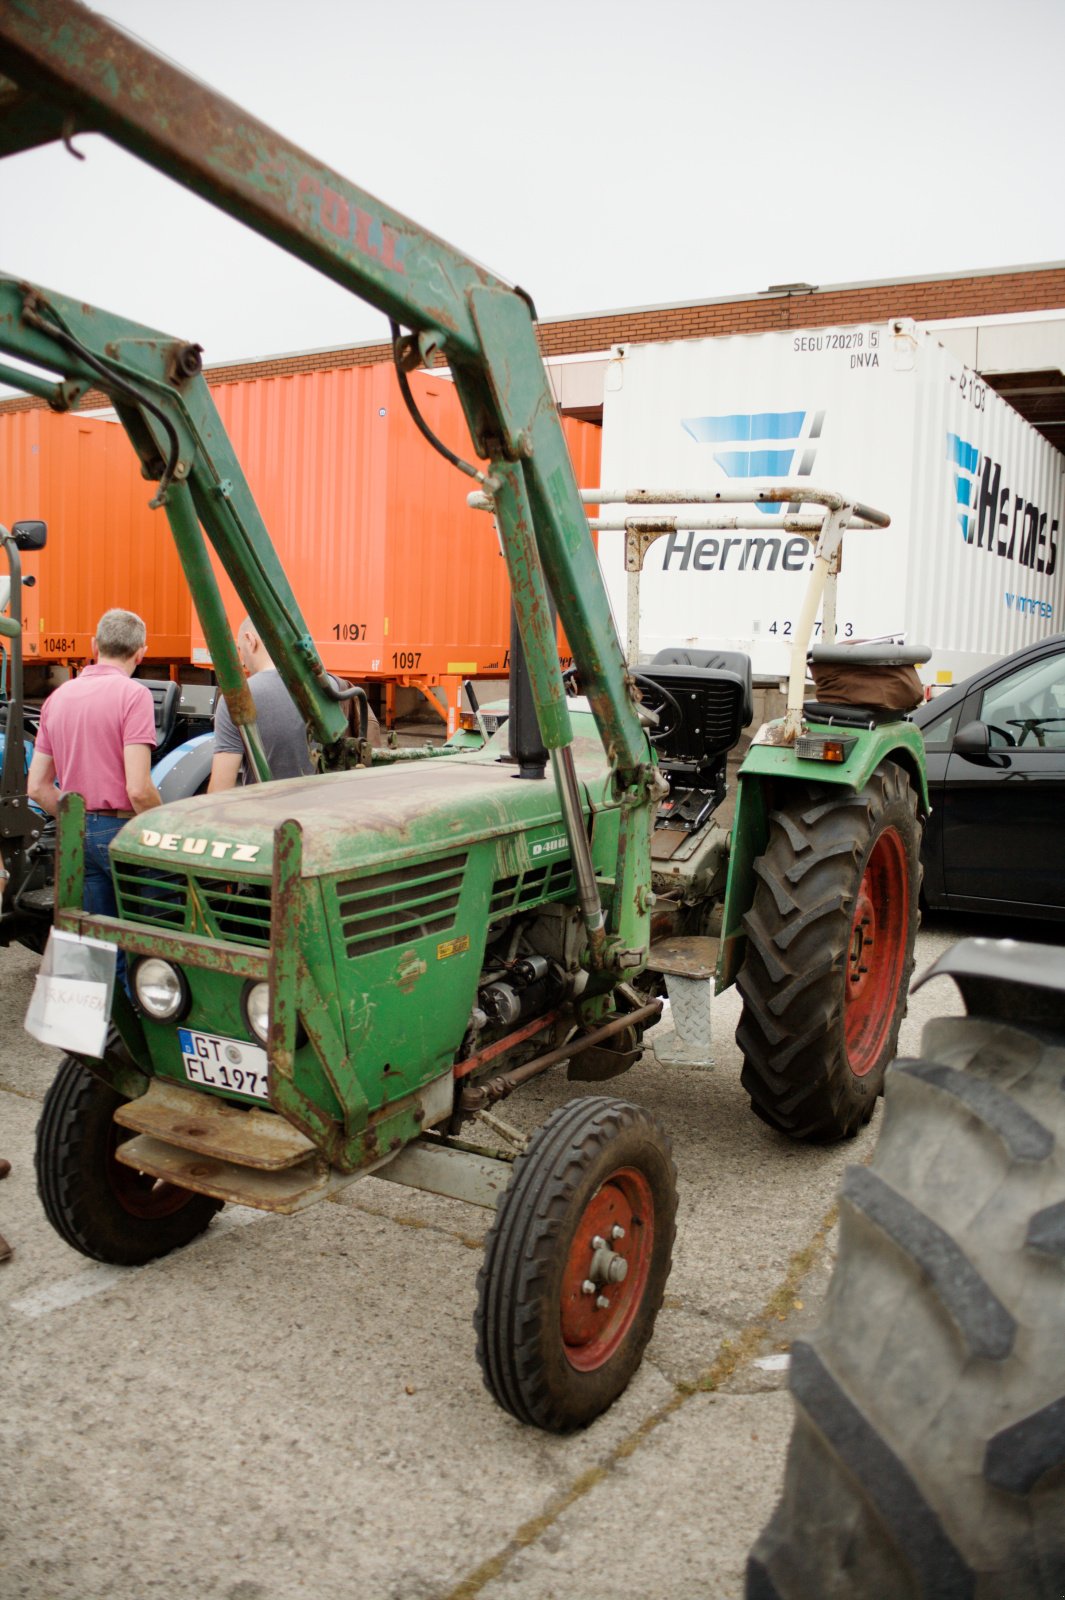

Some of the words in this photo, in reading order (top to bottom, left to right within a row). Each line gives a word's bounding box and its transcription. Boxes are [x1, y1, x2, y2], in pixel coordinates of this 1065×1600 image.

[793, 337, 823, 352] SEGU
[826, 332, 864, 349] 720278
[850, 353, 879, 369] DNVA
[977, 455, 1059, 576] Hermes
[662, 531, 814, 571] Herme
[333, 624, 367, 640] 1097
[44, 638, 76, 652] 1048-1
[392, 652, 422, 669] 1097
[140, 829, 261, 863] DEUTZ
[195, 1036, 220, 1062] GT
[187, 1057, 215, 1083] FL
